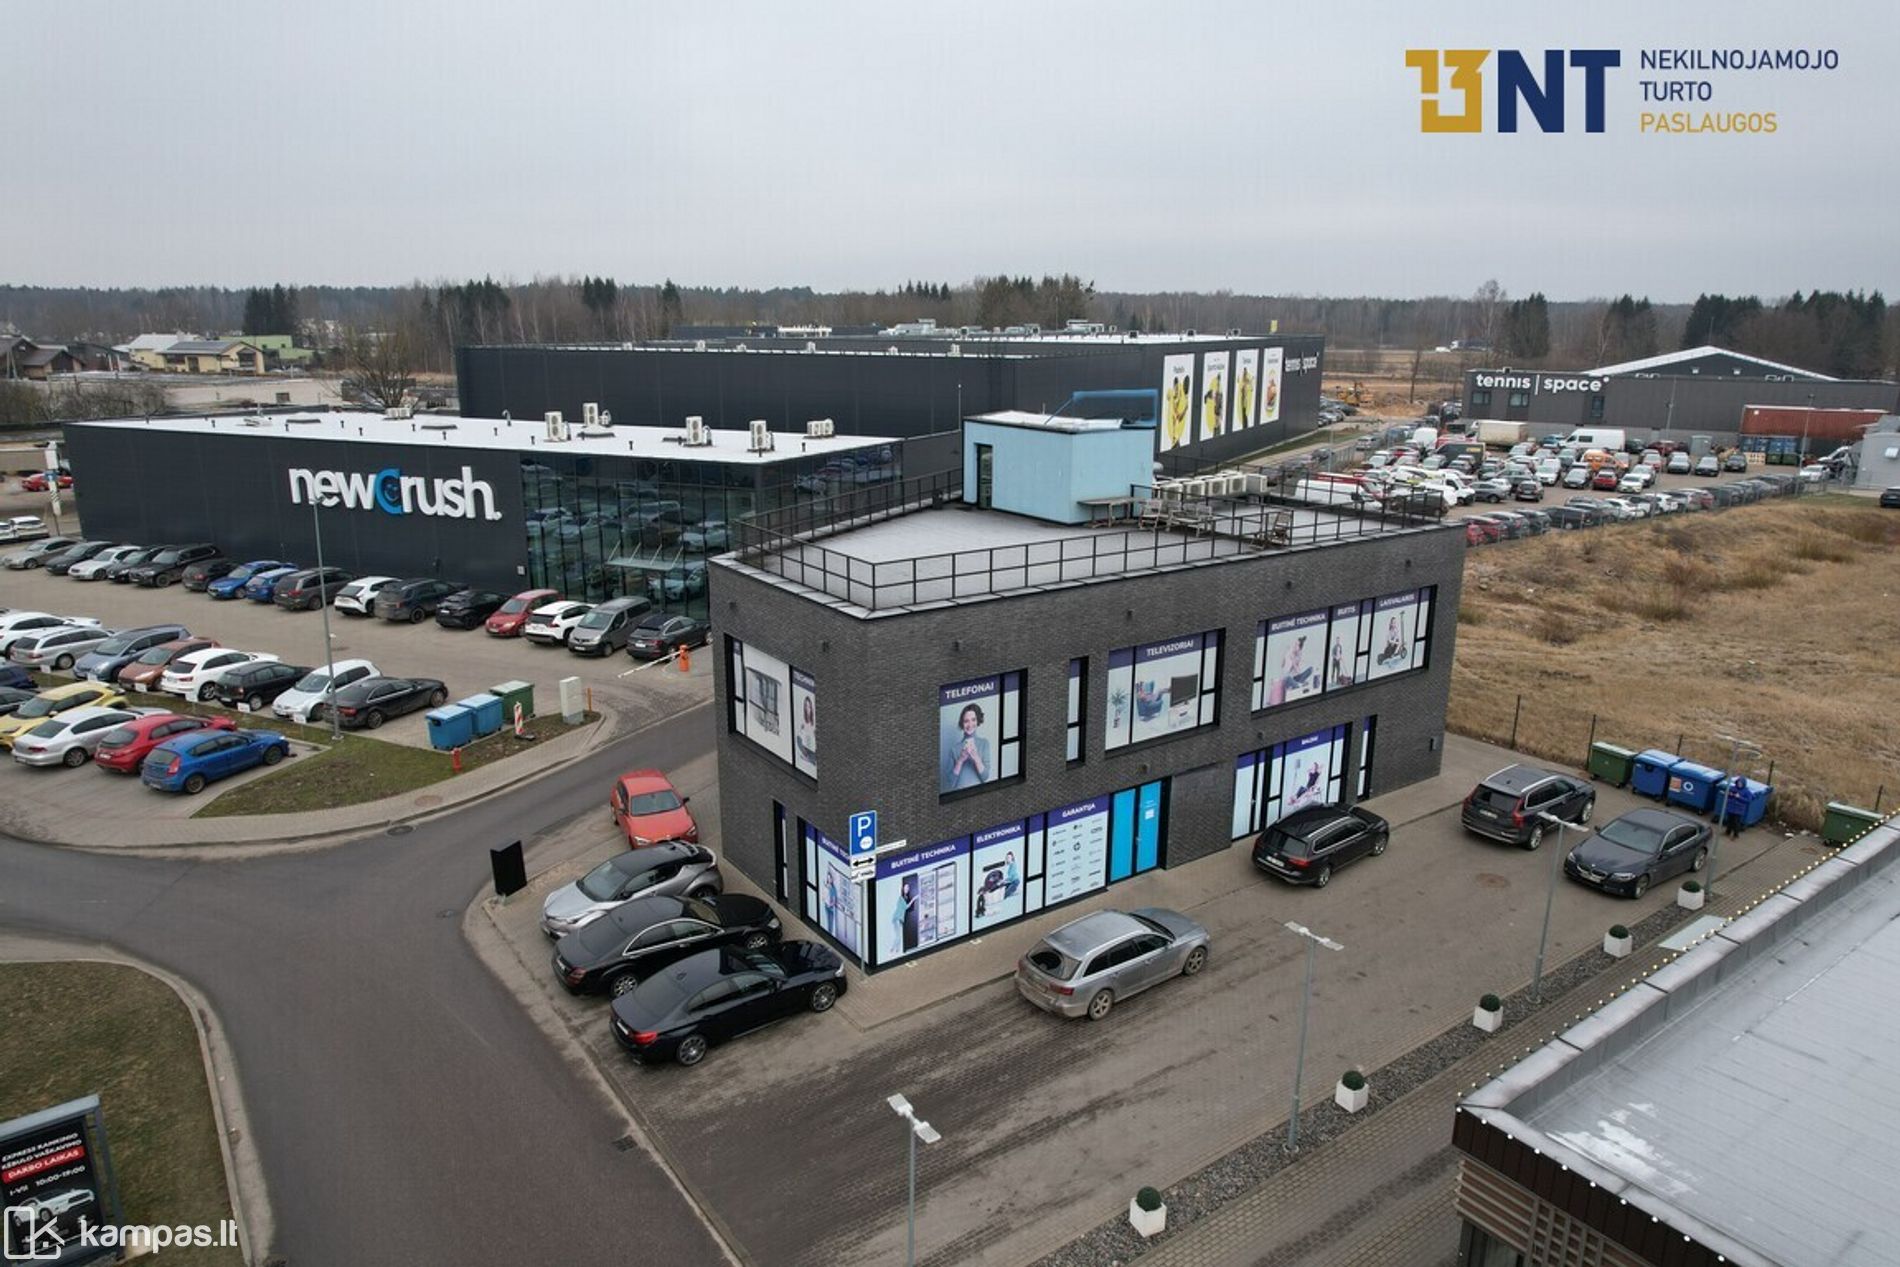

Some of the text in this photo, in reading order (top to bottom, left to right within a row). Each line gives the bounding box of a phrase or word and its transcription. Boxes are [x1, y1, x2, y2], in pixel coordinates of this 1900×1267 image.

[1476, 374, 1602, 393] tennis space
[1146, 640, 1194, 657] TELEVIZORIAI
[945, 681, 995, 699] TELEFONAI
[1062, 802, 1096, 818] GARANTIJA
[857, 816, 872, 838] P
[976, 825, 1022, 843] ELEKTRONIKA
[920, 844, 956, 861] TECHNIKA
[8, 1149, 79, 1179] DARBO LAIKAS
